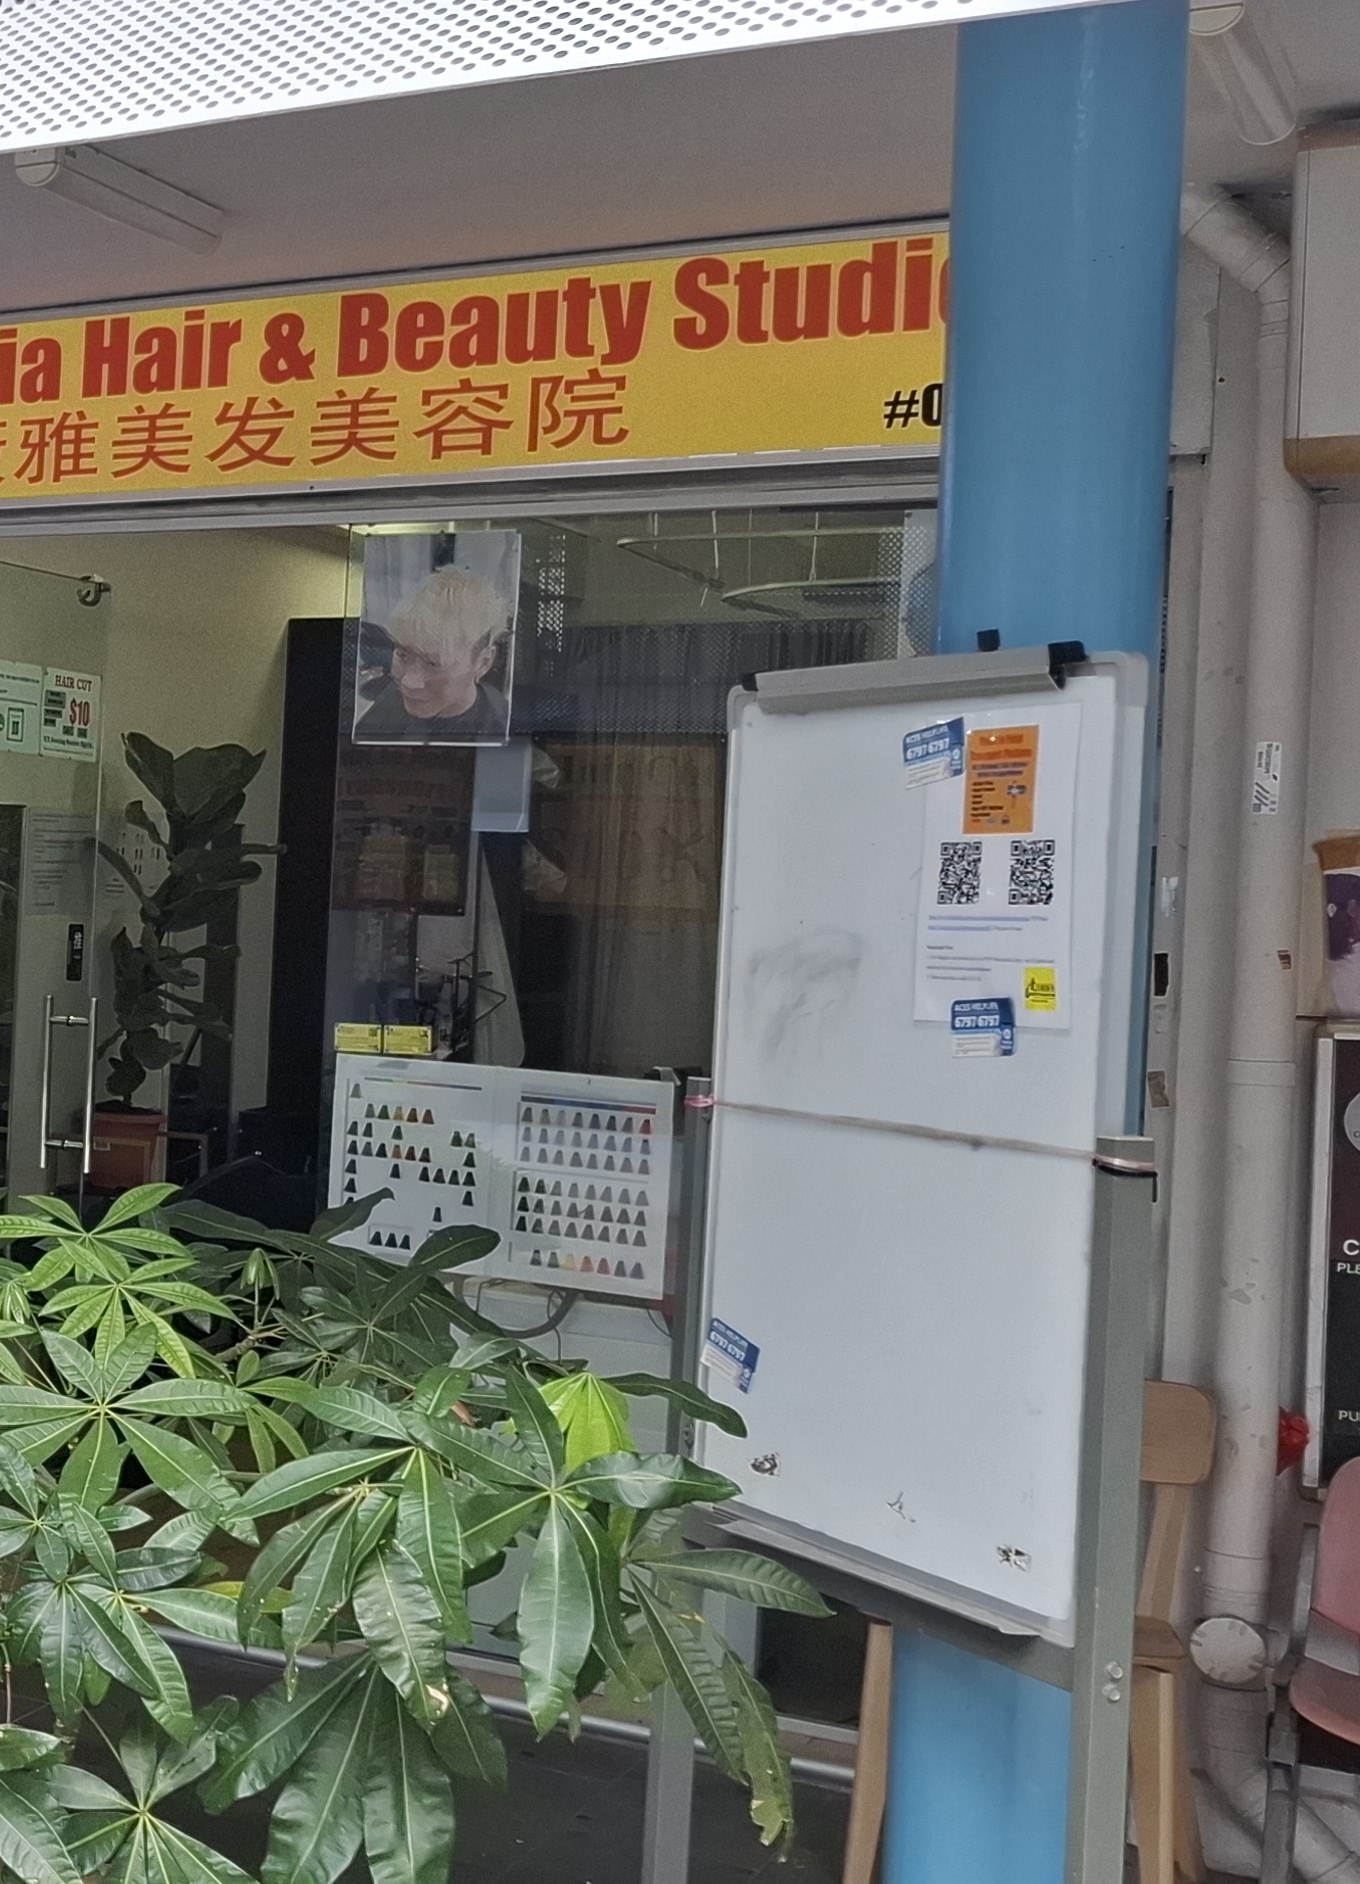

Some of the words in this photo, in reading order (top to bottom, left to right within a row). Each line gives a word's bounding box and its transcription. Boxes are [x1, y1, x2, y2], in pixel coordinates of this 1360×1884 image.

[81, 308, 245, 400] Hair
[257, 311, 317, 385] &
[338, 278, 652, 375] Beauty
[672, 236, 950, 352] Studi
[55, 675, 75, 689] HAIR
[76, 678, 92, 692] CUT
[69, 697, 91, 727] $10
